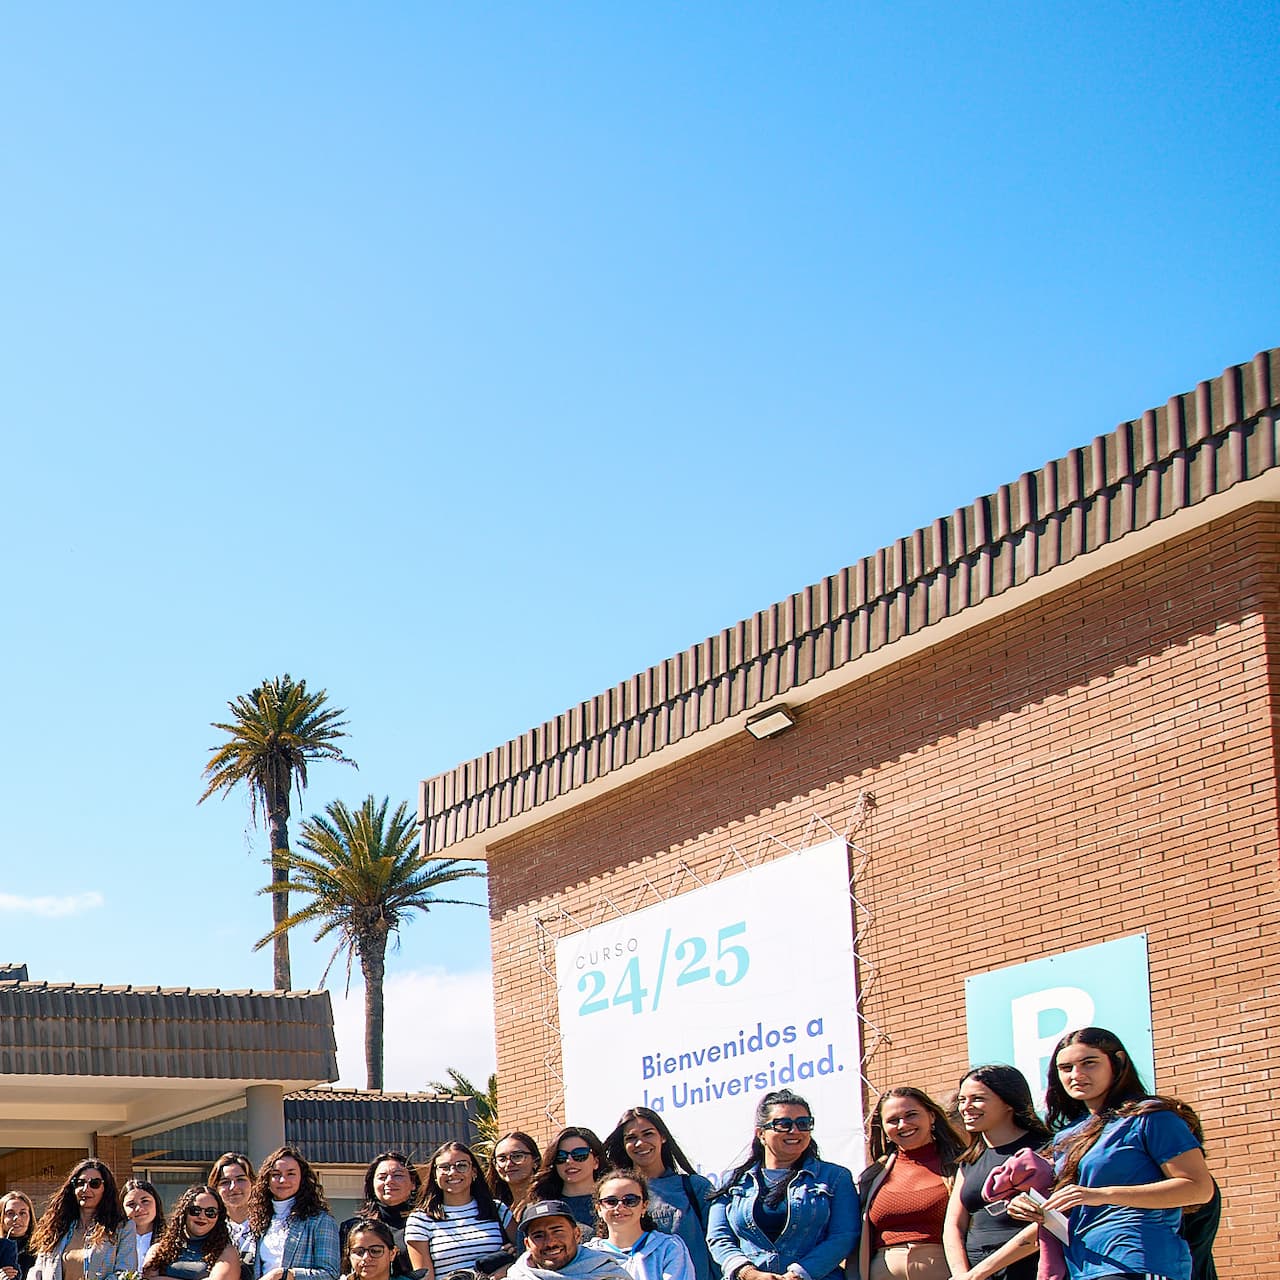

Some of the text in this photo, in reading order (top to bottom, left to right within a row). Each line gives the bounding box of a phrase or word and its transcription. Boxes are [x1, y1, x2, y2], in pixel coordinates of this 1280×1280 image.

[575, 937, 638, 970] CURSO
[576, 920, 750, 1016] 24/25
[641, 1017, 824, 1080] Bienvenidos a
[643, 1044, 844, 1113] la Universidad.
